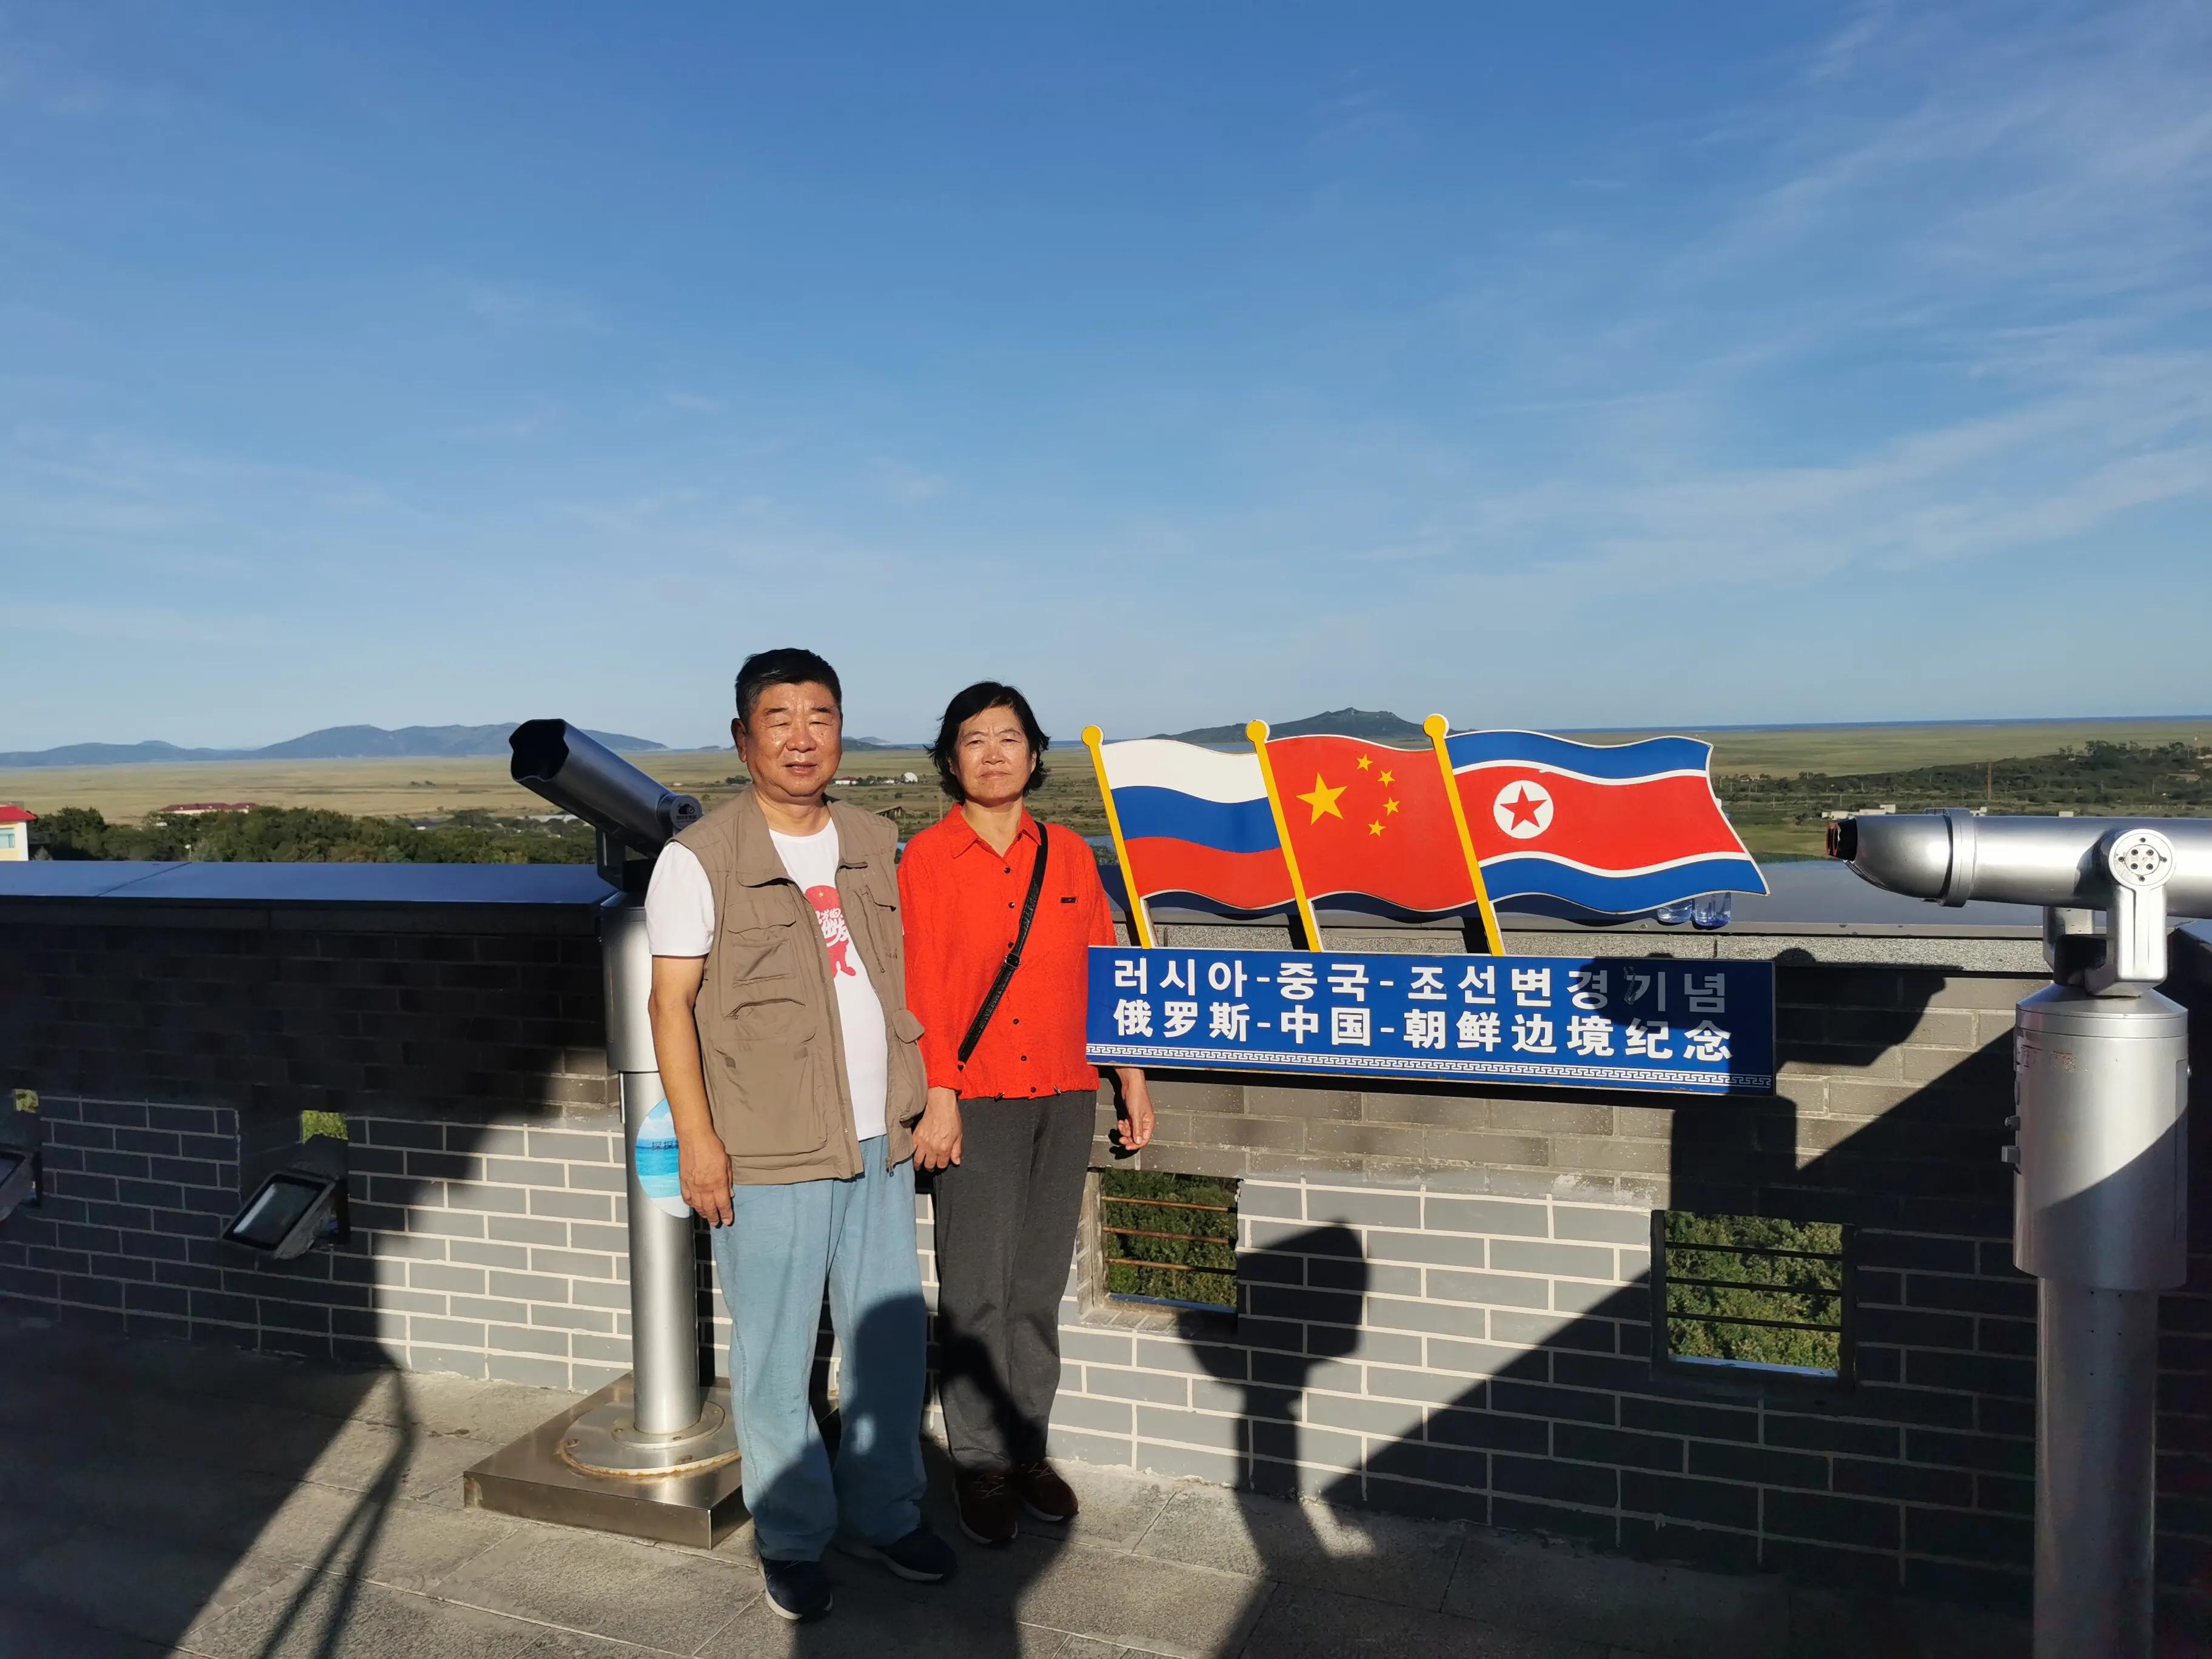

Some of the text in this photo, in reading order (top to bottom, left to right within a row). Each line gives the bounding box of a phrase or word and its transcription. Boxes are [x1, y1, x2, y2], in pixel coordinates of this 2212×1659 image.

[1113, 999, 1733, 1062] 俄罗斯-中国-朝鲜边境纪念
